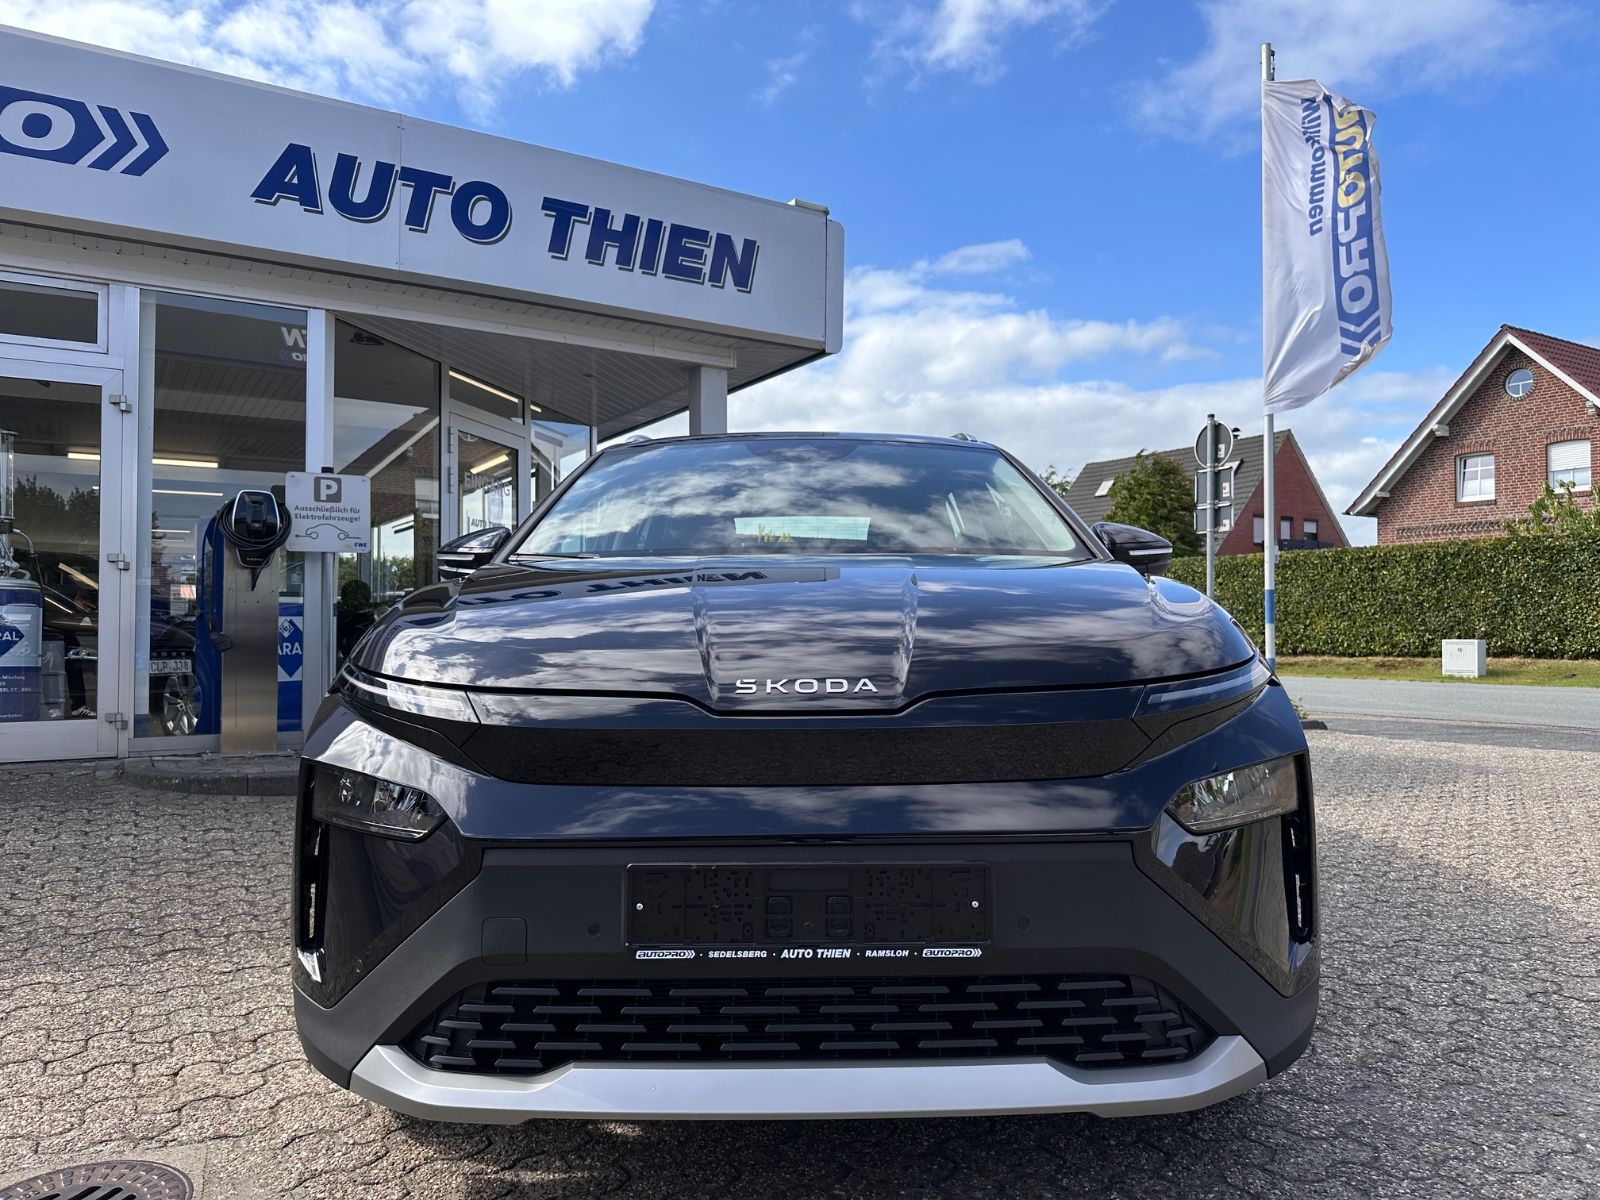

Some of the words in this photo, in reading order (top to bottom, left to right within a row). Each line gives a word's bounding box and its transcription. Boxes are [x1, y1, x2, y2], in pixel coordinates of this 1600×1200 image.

[250, 142, 512, 246] AUTO
[540, 196, 760, 293] THIEN
[320, 479, 339, 501] P
[294, 504, 349, 514] Ausschließlich
[294, 513, 361, 523] Elektrofahrzeuge!
[708, 950, 767, 958] SEDELSBERG
[780, 948, 813, 959] AUTO
[816, 948, 851, 959] THIEN
[865, 949, 909, 957] RAMSLOH
